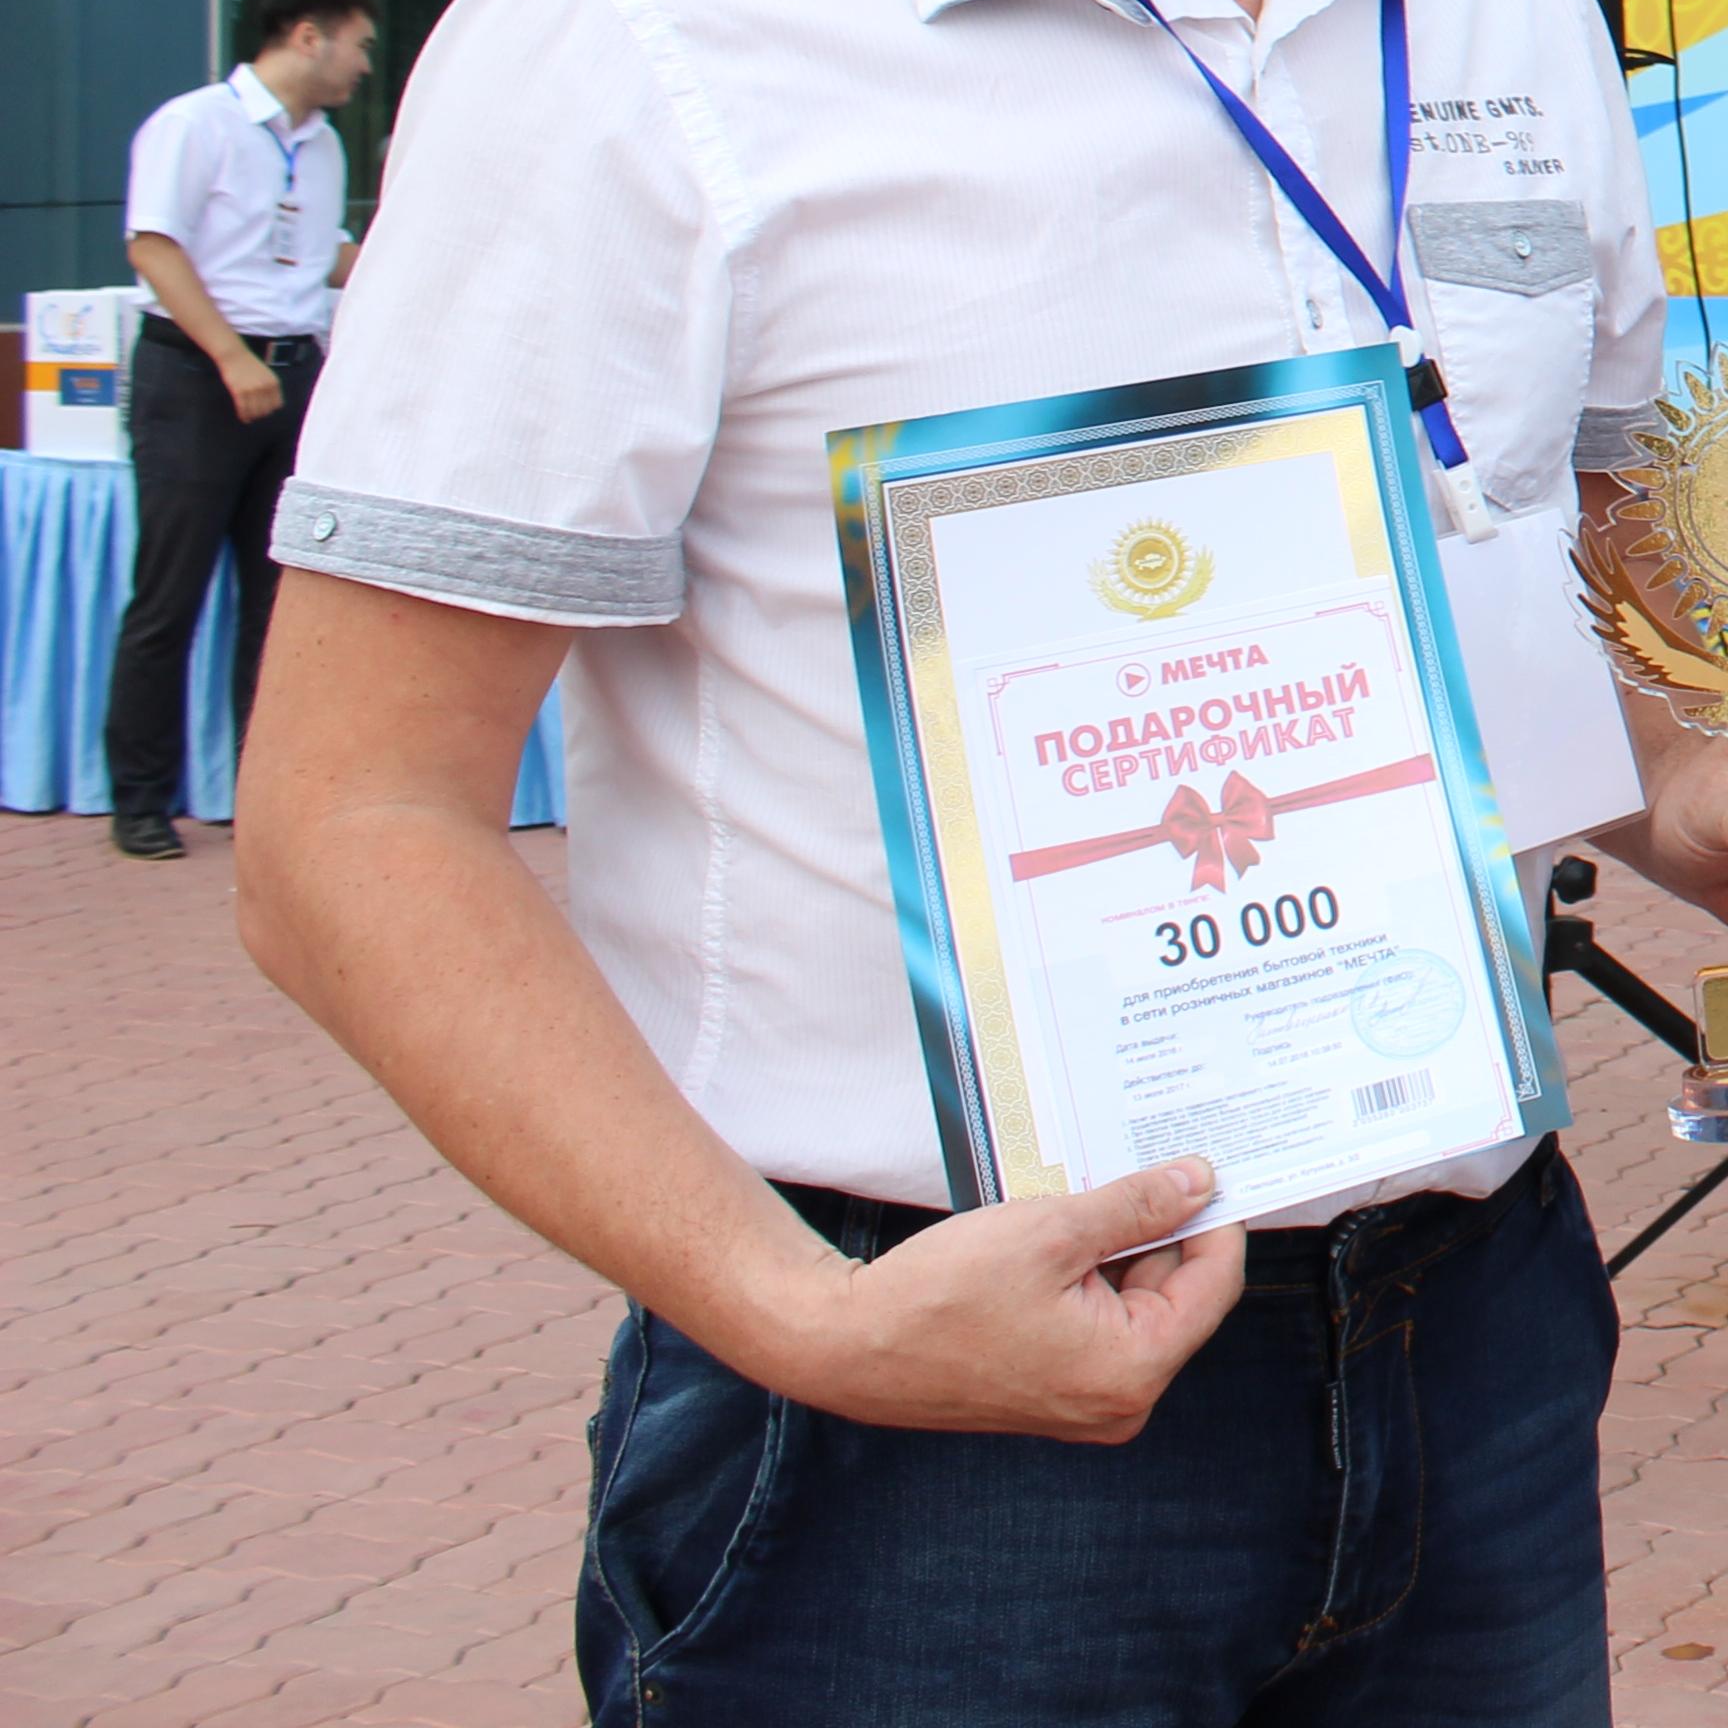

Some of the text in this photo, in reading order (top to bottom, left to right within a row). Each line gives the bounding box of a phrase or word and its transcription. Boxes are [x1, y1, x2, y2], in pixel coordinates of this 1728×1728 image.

[1409, 96, 1545, 123] ENUINE GMTS.
[1161, 644, 1269, 685] МЕЧТА
[1034, 661, 1371, 766] ПОДАРОЧНЫЙ
[1061, 706, 1356, 797] СЕРТИФИКАТ
[1155, 885, 1340, 968] 30 000
[1120, 944, 1402, 1027] в сети розничных магазинов "МЕЧТА"
[1122, 932, 1388, 1009] для приобретения бытовой техники
